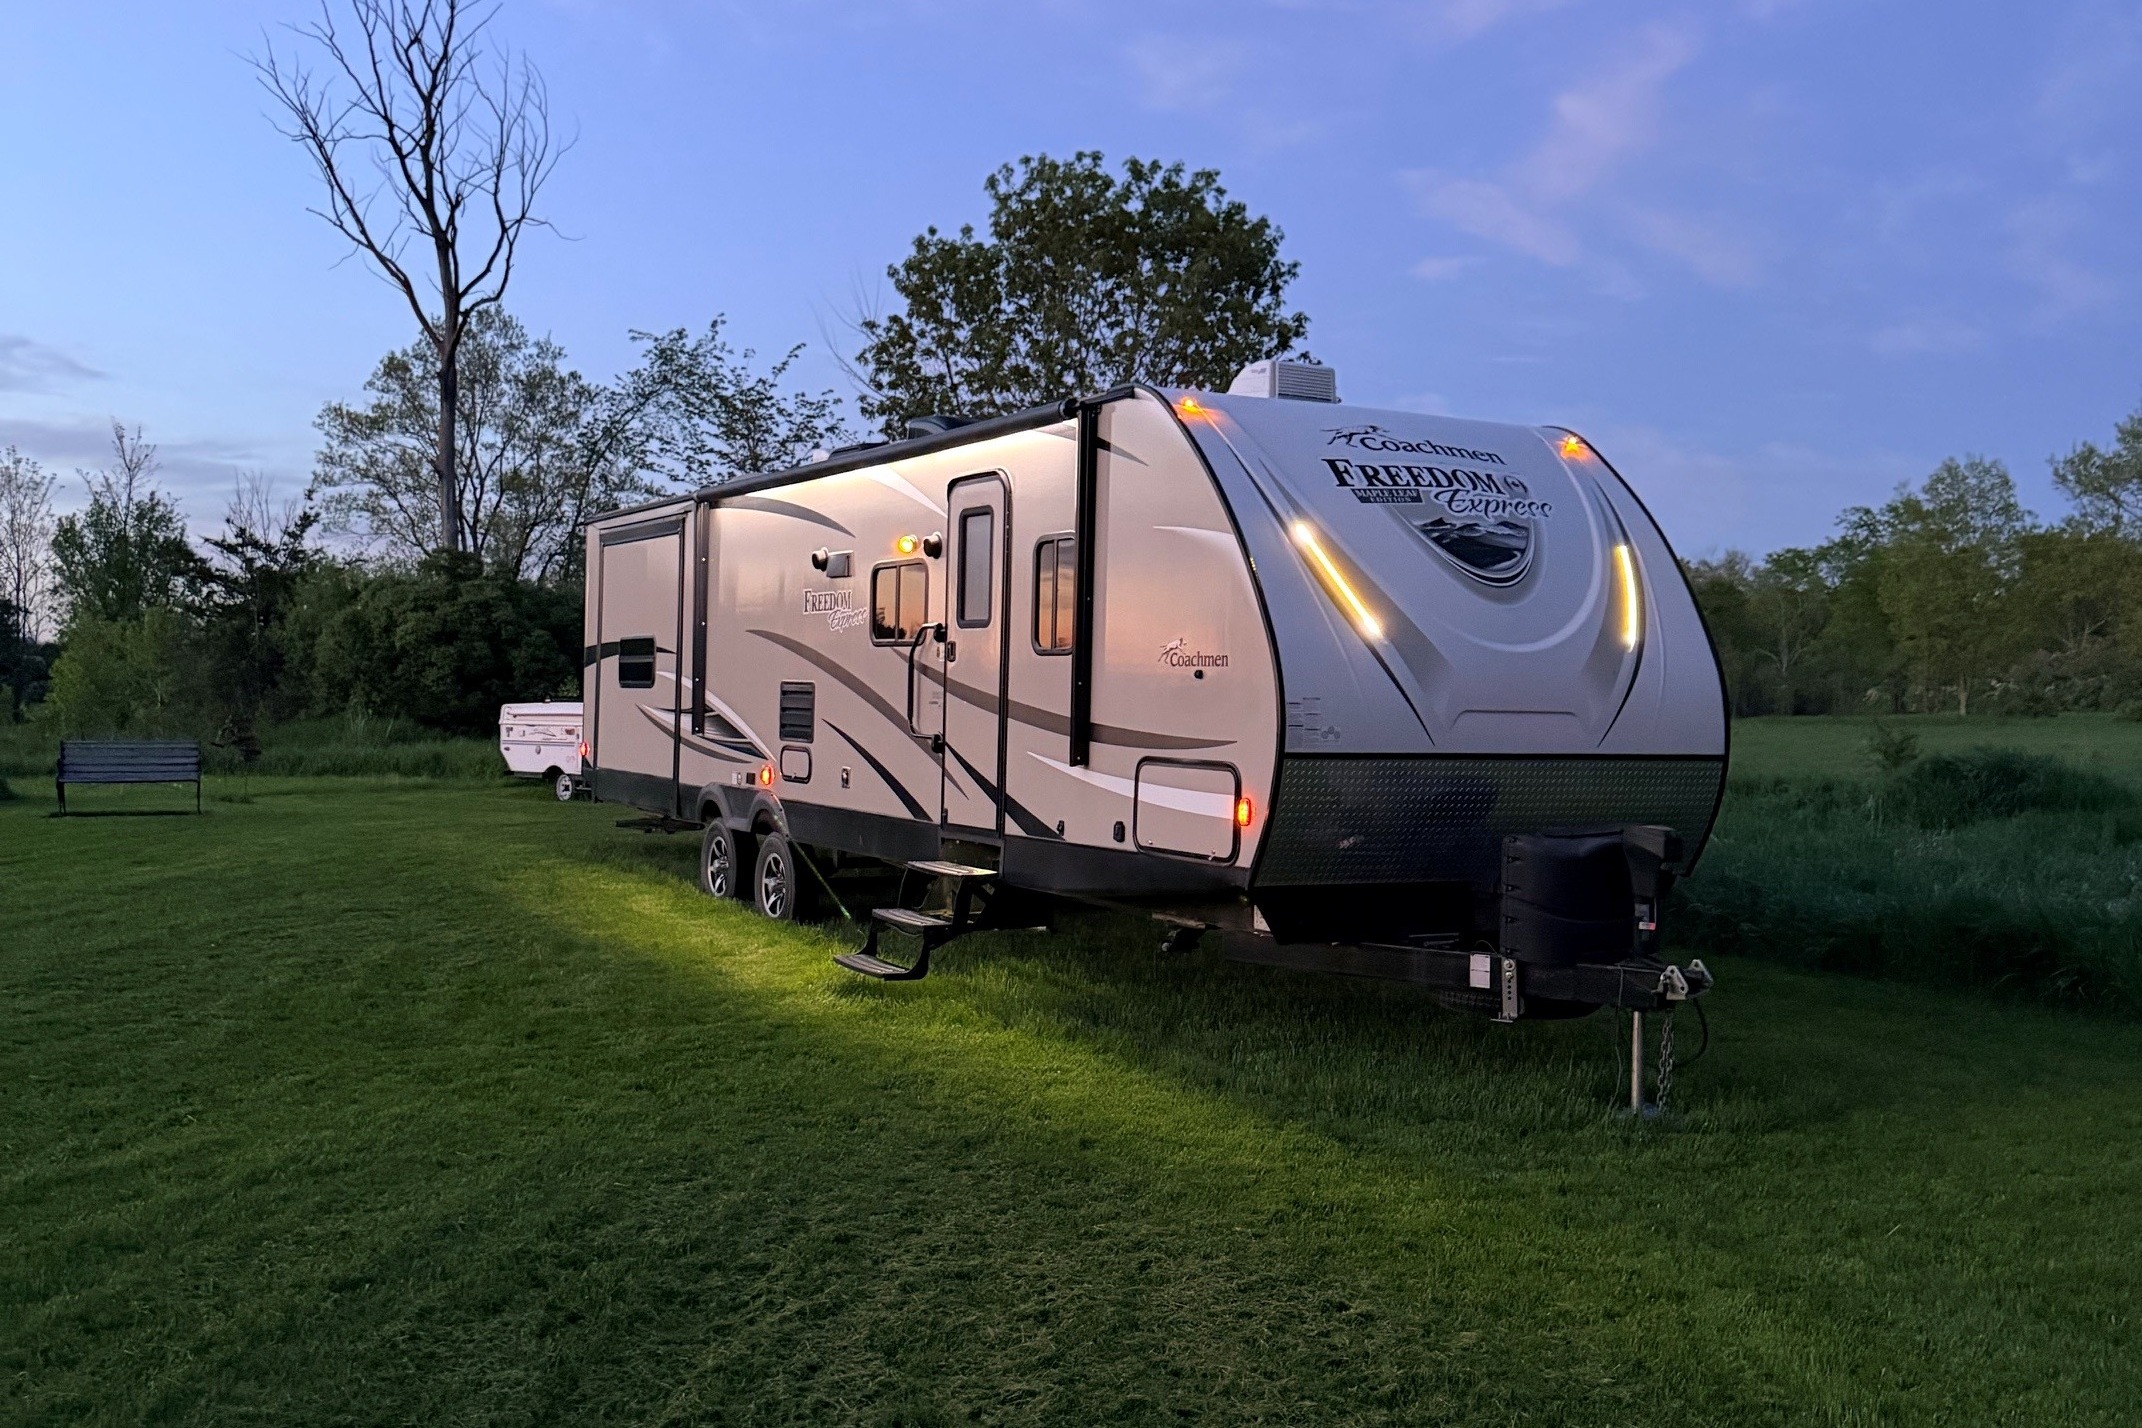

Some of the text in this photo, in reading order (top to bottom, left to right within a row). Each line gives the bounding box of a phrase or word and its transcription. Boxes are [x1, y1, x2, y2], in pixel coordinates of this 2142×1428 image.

[1360, 436, 1508, 466] Coachmen
[1321, 458, 1505, 495] FREEDOM
[1433, 488, 1553, 520] Express
[803, 590, 852, 613] FREEDOM
[828, 608, 868, 632] Express
[1170, 651, 1229, 667] Coachmen
